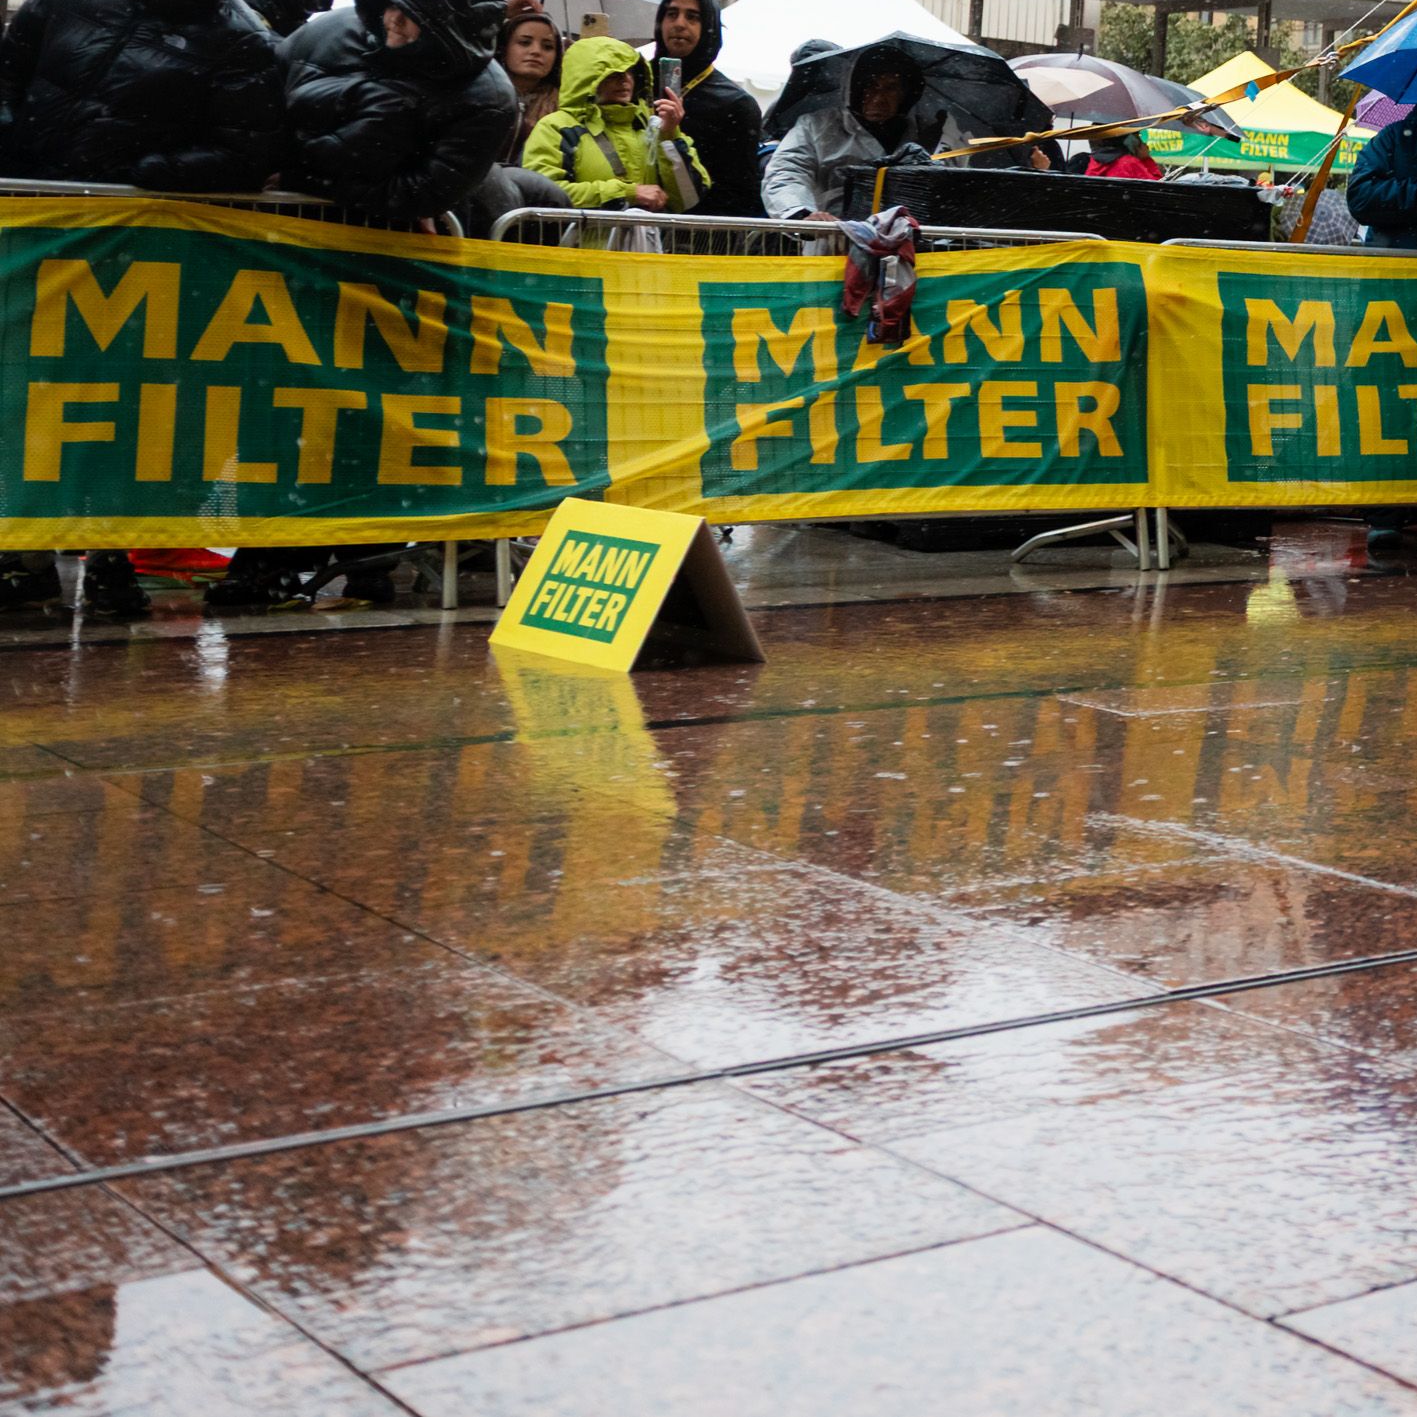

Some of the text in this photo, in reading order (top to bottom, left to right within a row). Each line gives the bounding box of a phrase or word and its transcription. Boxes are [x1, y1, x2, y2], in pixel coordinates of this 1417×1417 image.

[1241, 142, 1289, 159] FILTER
[29, 259, 577, 378] MANN
[23, 382, 579, 488] FILTER
[730, 380, 1124, 471] FILTER
[551, 537, 651, 587] MANN
[531, 580, 629, 633] FILTER
